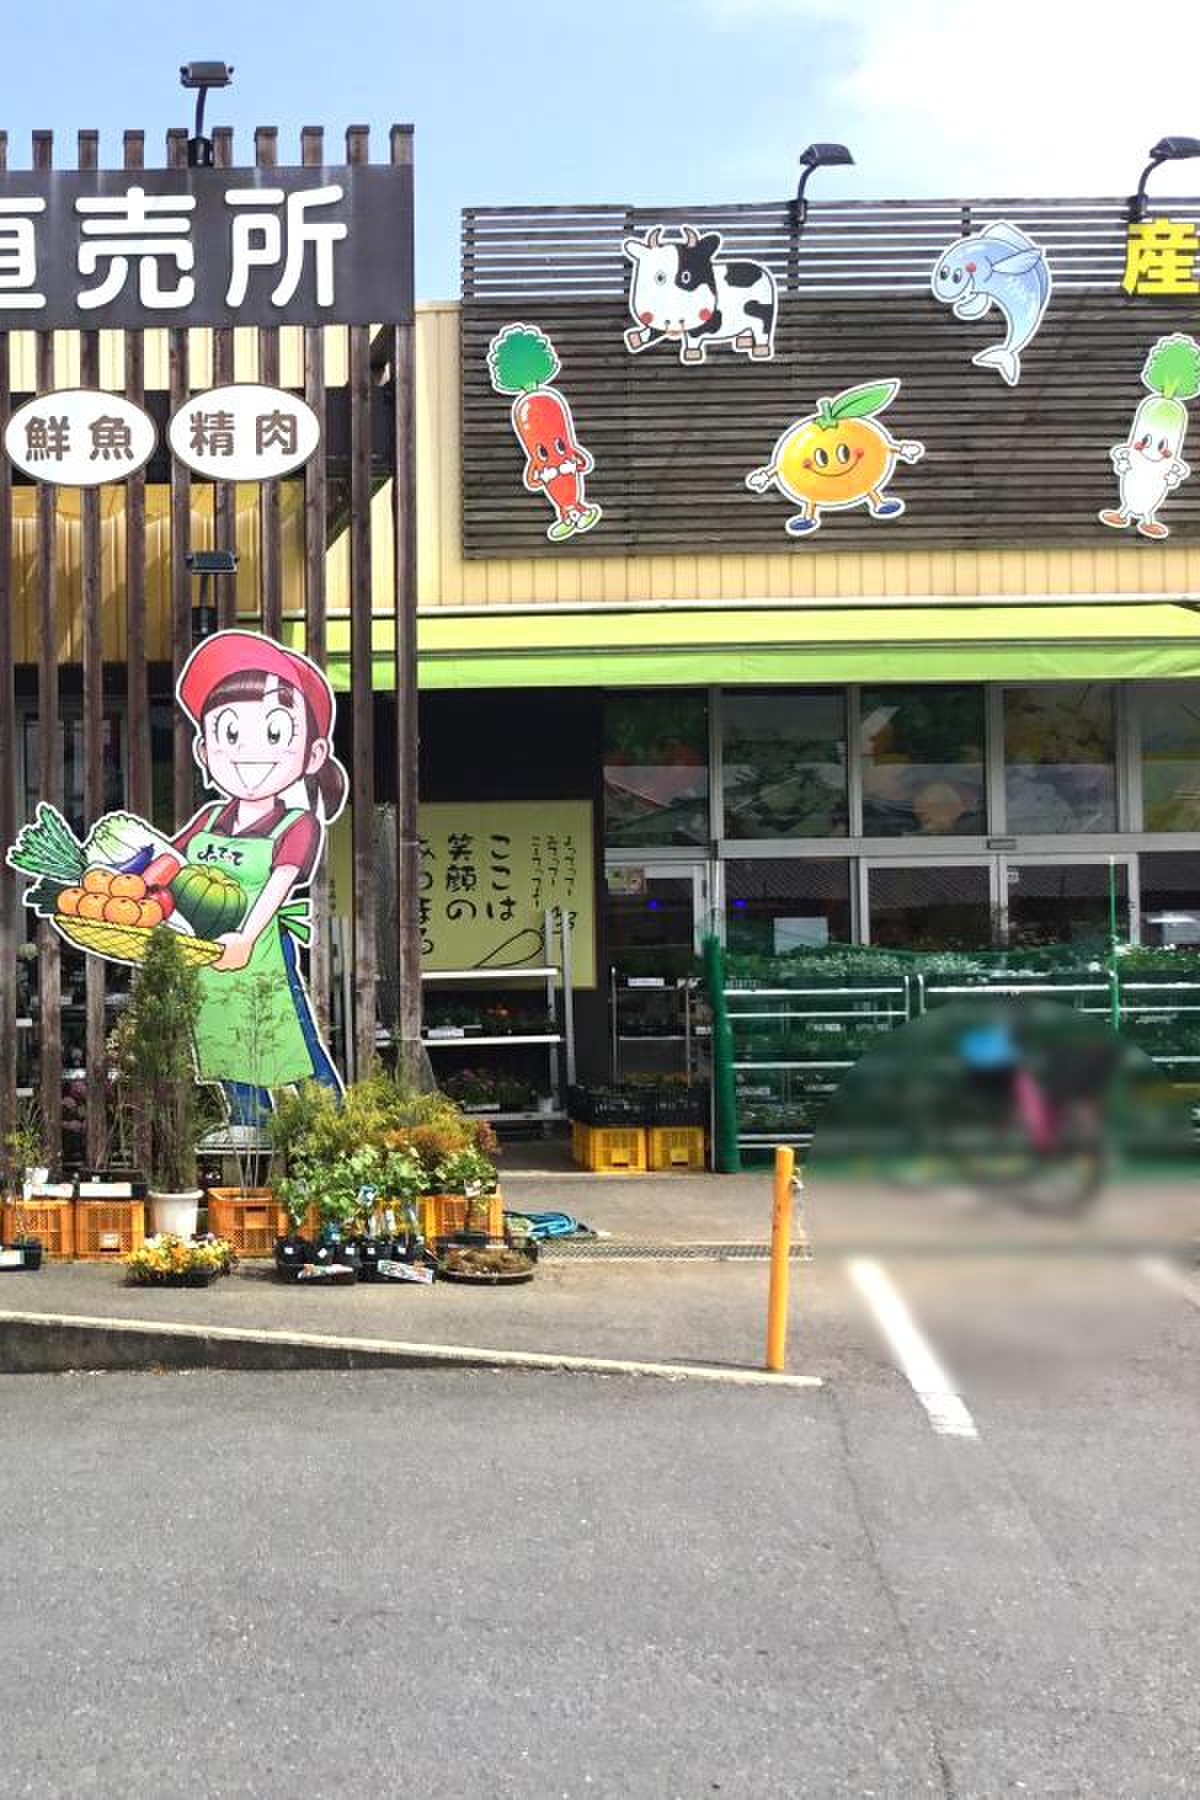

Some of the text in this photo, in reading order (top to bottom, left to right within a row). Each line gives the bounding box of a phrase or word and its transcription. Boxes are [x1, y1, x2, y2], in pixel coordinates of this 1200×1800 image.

[1122, 216, 1200, 295] 産
[24, 413, 136, 465] 鮮魚
[189, 408, 300, 459] 精肉
[446, 833, 477, 920] 笑顔の
[486, 834, 516, 922] ここは
